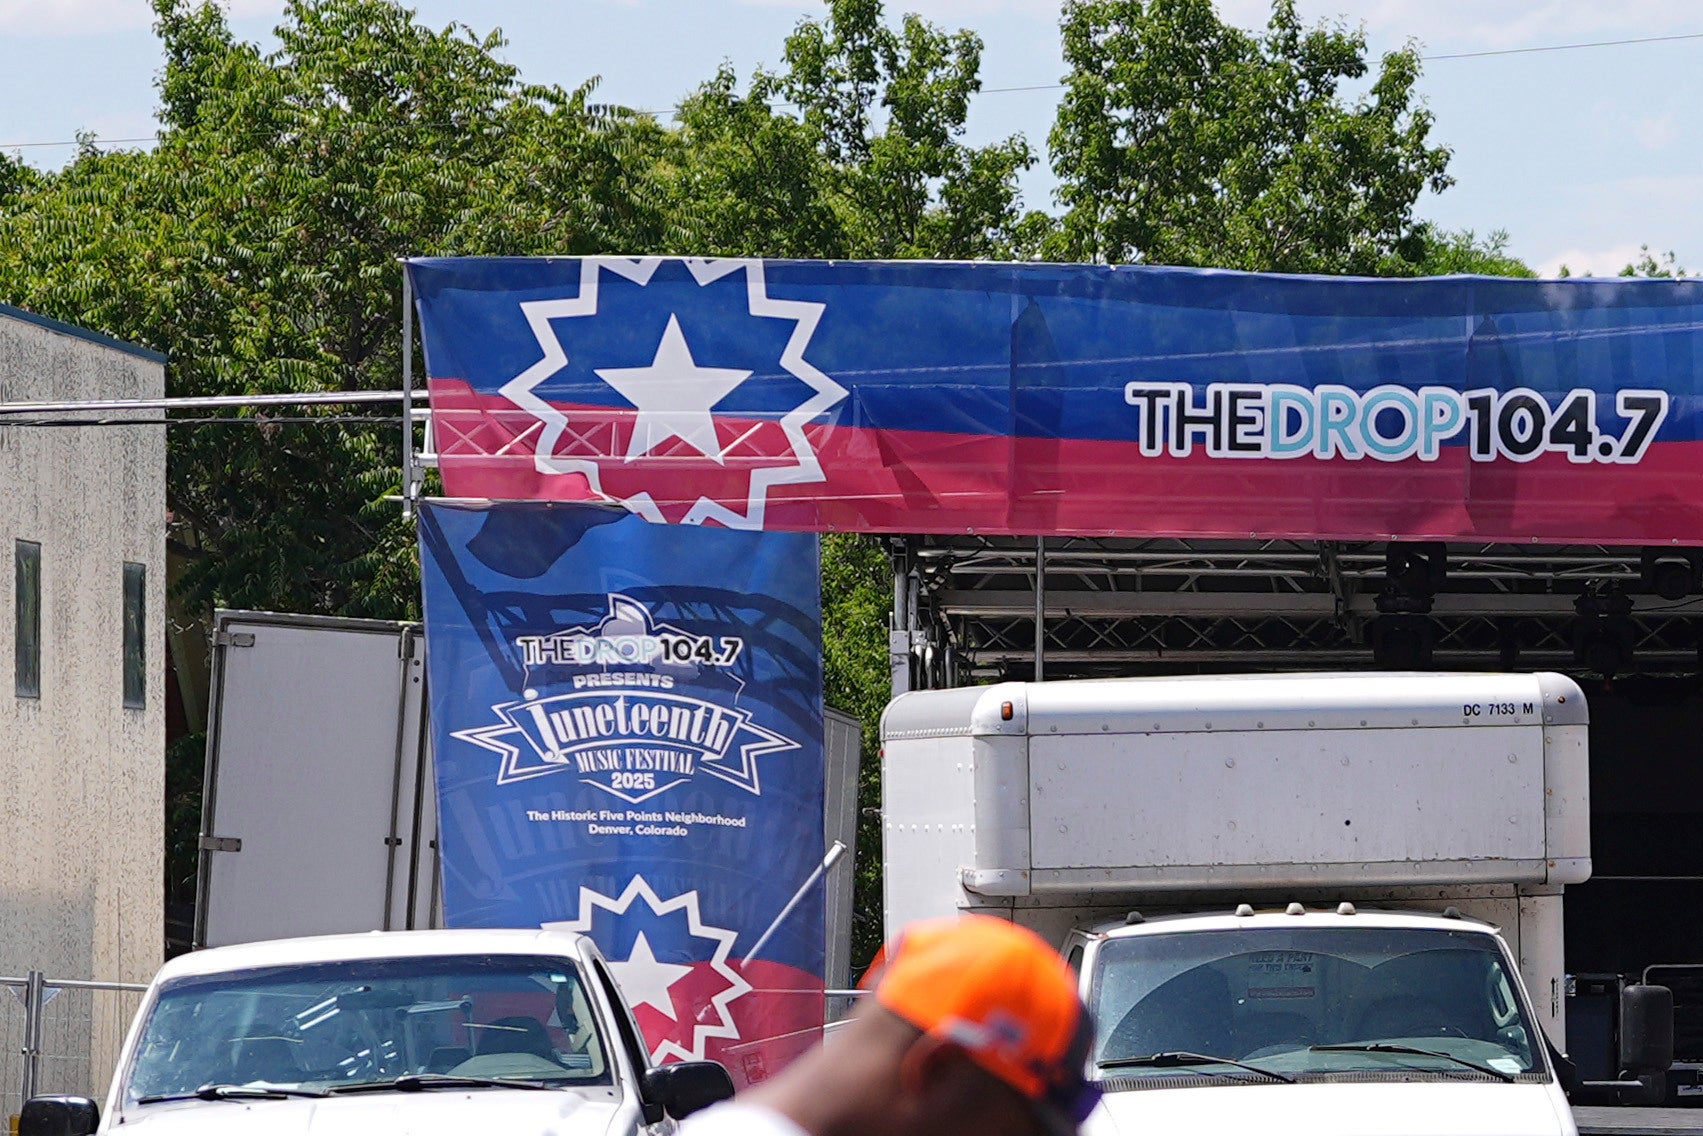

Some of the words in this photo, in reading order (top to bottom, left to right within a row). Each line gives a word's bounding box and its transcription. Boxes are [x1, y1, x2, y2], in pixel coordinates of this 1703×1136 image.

[573, 671, 675, 689] PRESENTS
[1463, 704, 1481, 716] DC
[1489, 702, 1516, 715] 7133
[1523, 702, 1534, 714] M
[523, 689, 731, 761] Juneteenth
[575, 749, 623, 774] MUSIC
[627, 748, 695, 776] FESTIVAL
[611, 772, 656, 790] 2025
[527, 810, 549, 822] The
[552, 810, 597, 822] Historic
[600, 810, 624, 822] Five
[627, 811, 663, 823] Points
[665, 812, 746, 828] Neighborhood
[589, 824, 634, 836] Denver,
[636, 824, 688, 837] Colorado
